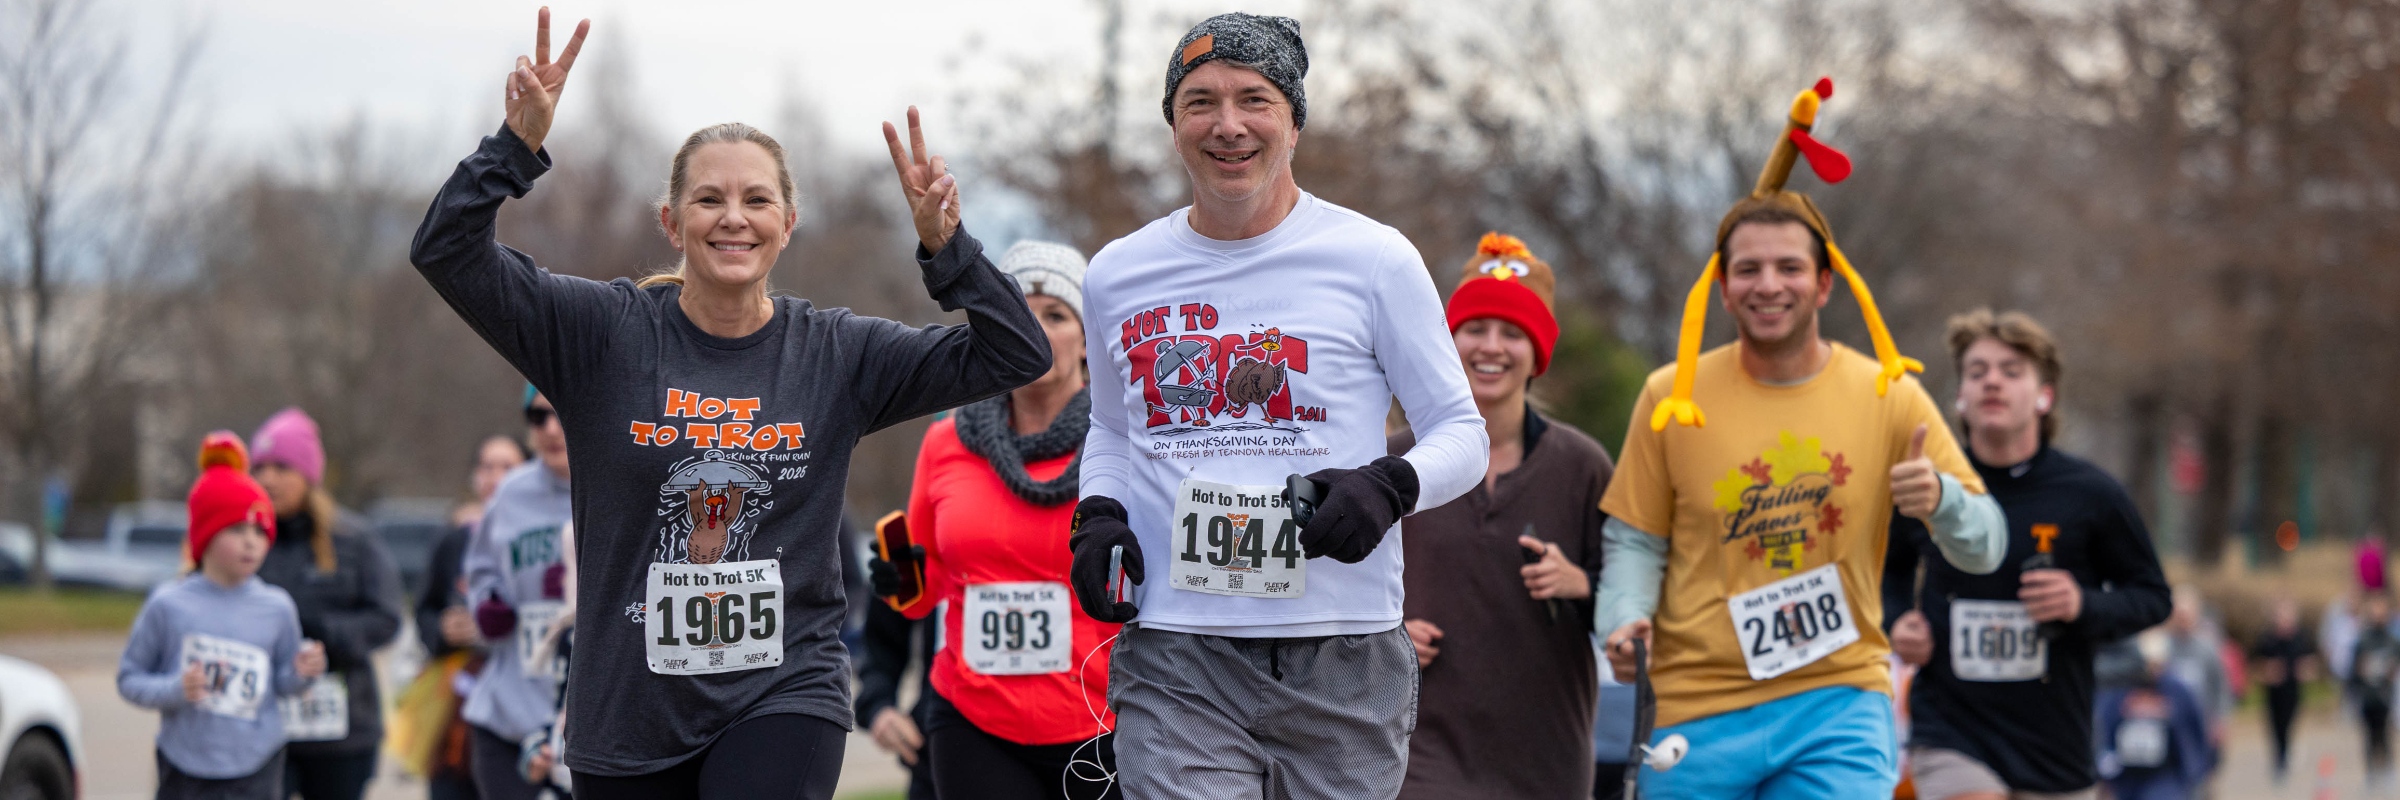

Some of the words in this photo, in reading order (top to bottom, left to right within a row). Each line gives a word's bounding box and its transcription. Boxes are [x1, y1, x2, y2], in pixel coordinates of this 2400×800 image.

[1121, 306, 1170, 352] HOT
[1180, 303, 1219, 331] TO
[664, 388, 761, 420] HOT
[1295, 406, 1327, 422] 2011
[630, 420, 678, 446] TO
[685, 422, 805, 451] TROT
[1153, 441, 1171, 450] ON
[1175, 436, 1268, 449] THANKSGIVING
[1273, 436, 1298, 447] DAY
[726, 452, 759, 461] 5K/10K
[768, 453, 790, 461] FUN
[792, 451, 811, 462] RUN
[1171, 450, 1200, 459] FRESH
[1203, 449, 1215, 458] BY
[1218, 448, 1265, 457] TENNOVA
[1268, 447, 1331, 457] HEALTHCARE
[778, 465, 808, 480] 2025
[1192, 488, 1214, 504] Hot
[1218, 492, 1233, 507] to
[1237, 493, 1266, 508] Trot
[1741, 481, 1830, 519] Falling
[1181, 512, 1301, 569] 1944
[1721, 508, 1802, 544] Leaves
[2030, 523, 2060, 553] T
[664, 572, 689, 586] Hot
[694, 573, 709, 586] to
[713, 570, 742, 585] Trot
[746, 568, 766, 583] 5K
[1744, 596, 1764, 610] Hot
[1767, 592, 1779, 602] to
[1782, 584, 1805, 597] Trot
[1807, 577, 1823, 587] 5K
[657, 591, 776, 646] 1965
[982, 610, 1051, 650] 993
[1744, 593, 1842, 658] 2408
[1961, 626, 2039, 659] 1609
